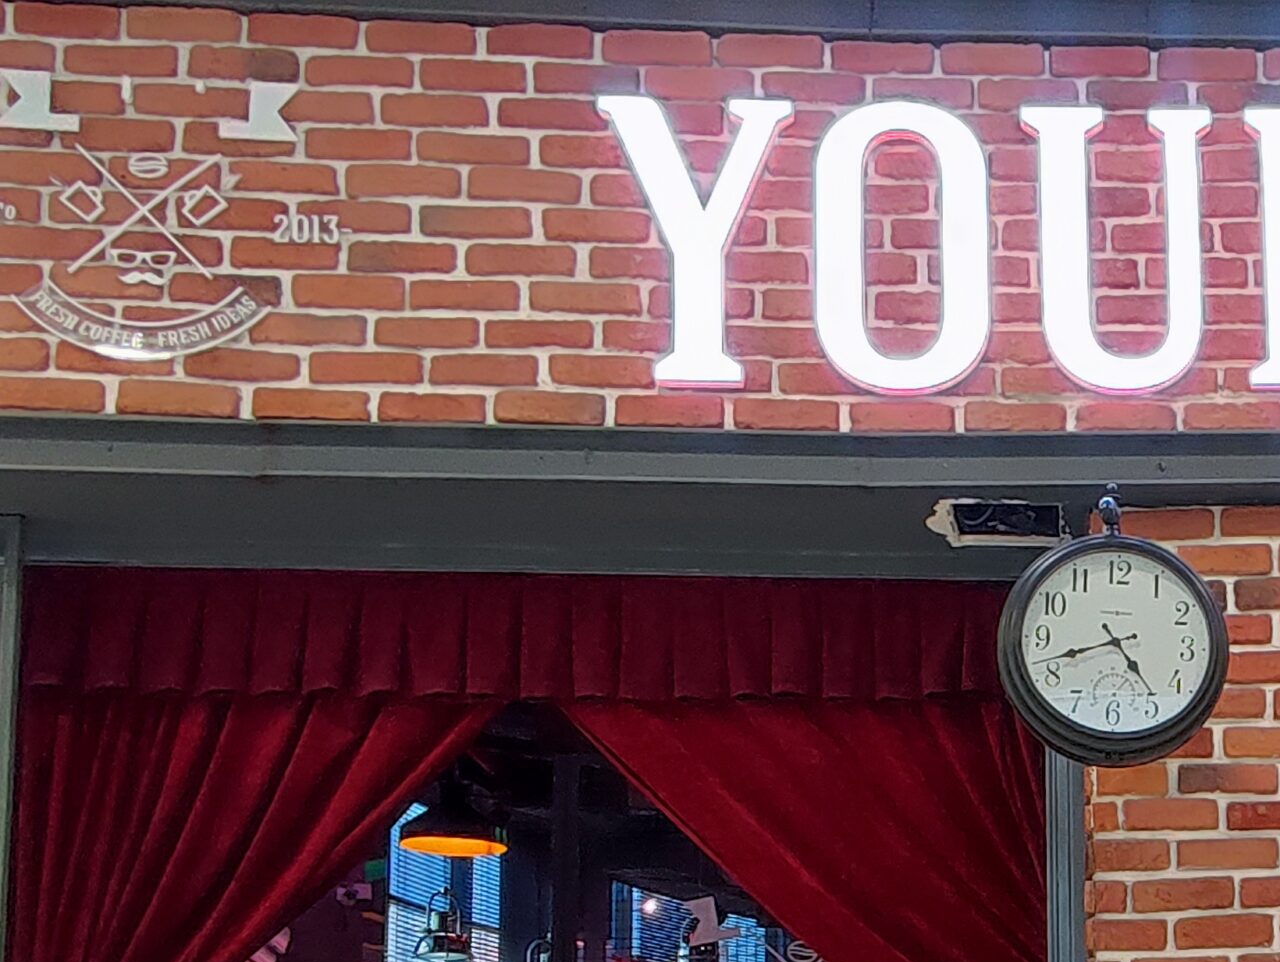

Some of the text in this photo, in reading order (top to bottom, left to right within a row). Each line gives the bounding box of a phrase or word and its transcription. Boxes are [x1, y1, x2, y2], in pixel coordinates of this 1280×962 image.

[33, 290, 79, 331] FRESH
[157, 323, 212, 348] FRESH
[212, 294, 257, 332] IDEAS
[1072, 563, 1089, 593] 11
[1109, 560, 1132, 585] 12
[1153, 573, 1160, 599] 1
[1043, 591, 1067, 616] 10
[1174, 600, 1190, 626] 2
[1035, 624, 1051, 650] 9
[1180, 635, 1195, 662] 3
[1045, 661, 1061, 687] 8
[1168, 669, 1182, 694] 4
[1070, 690, 1083, 713] 7
[1105, 700, 1120, 726] 6
[1144, 692, 1159, 719] 5
